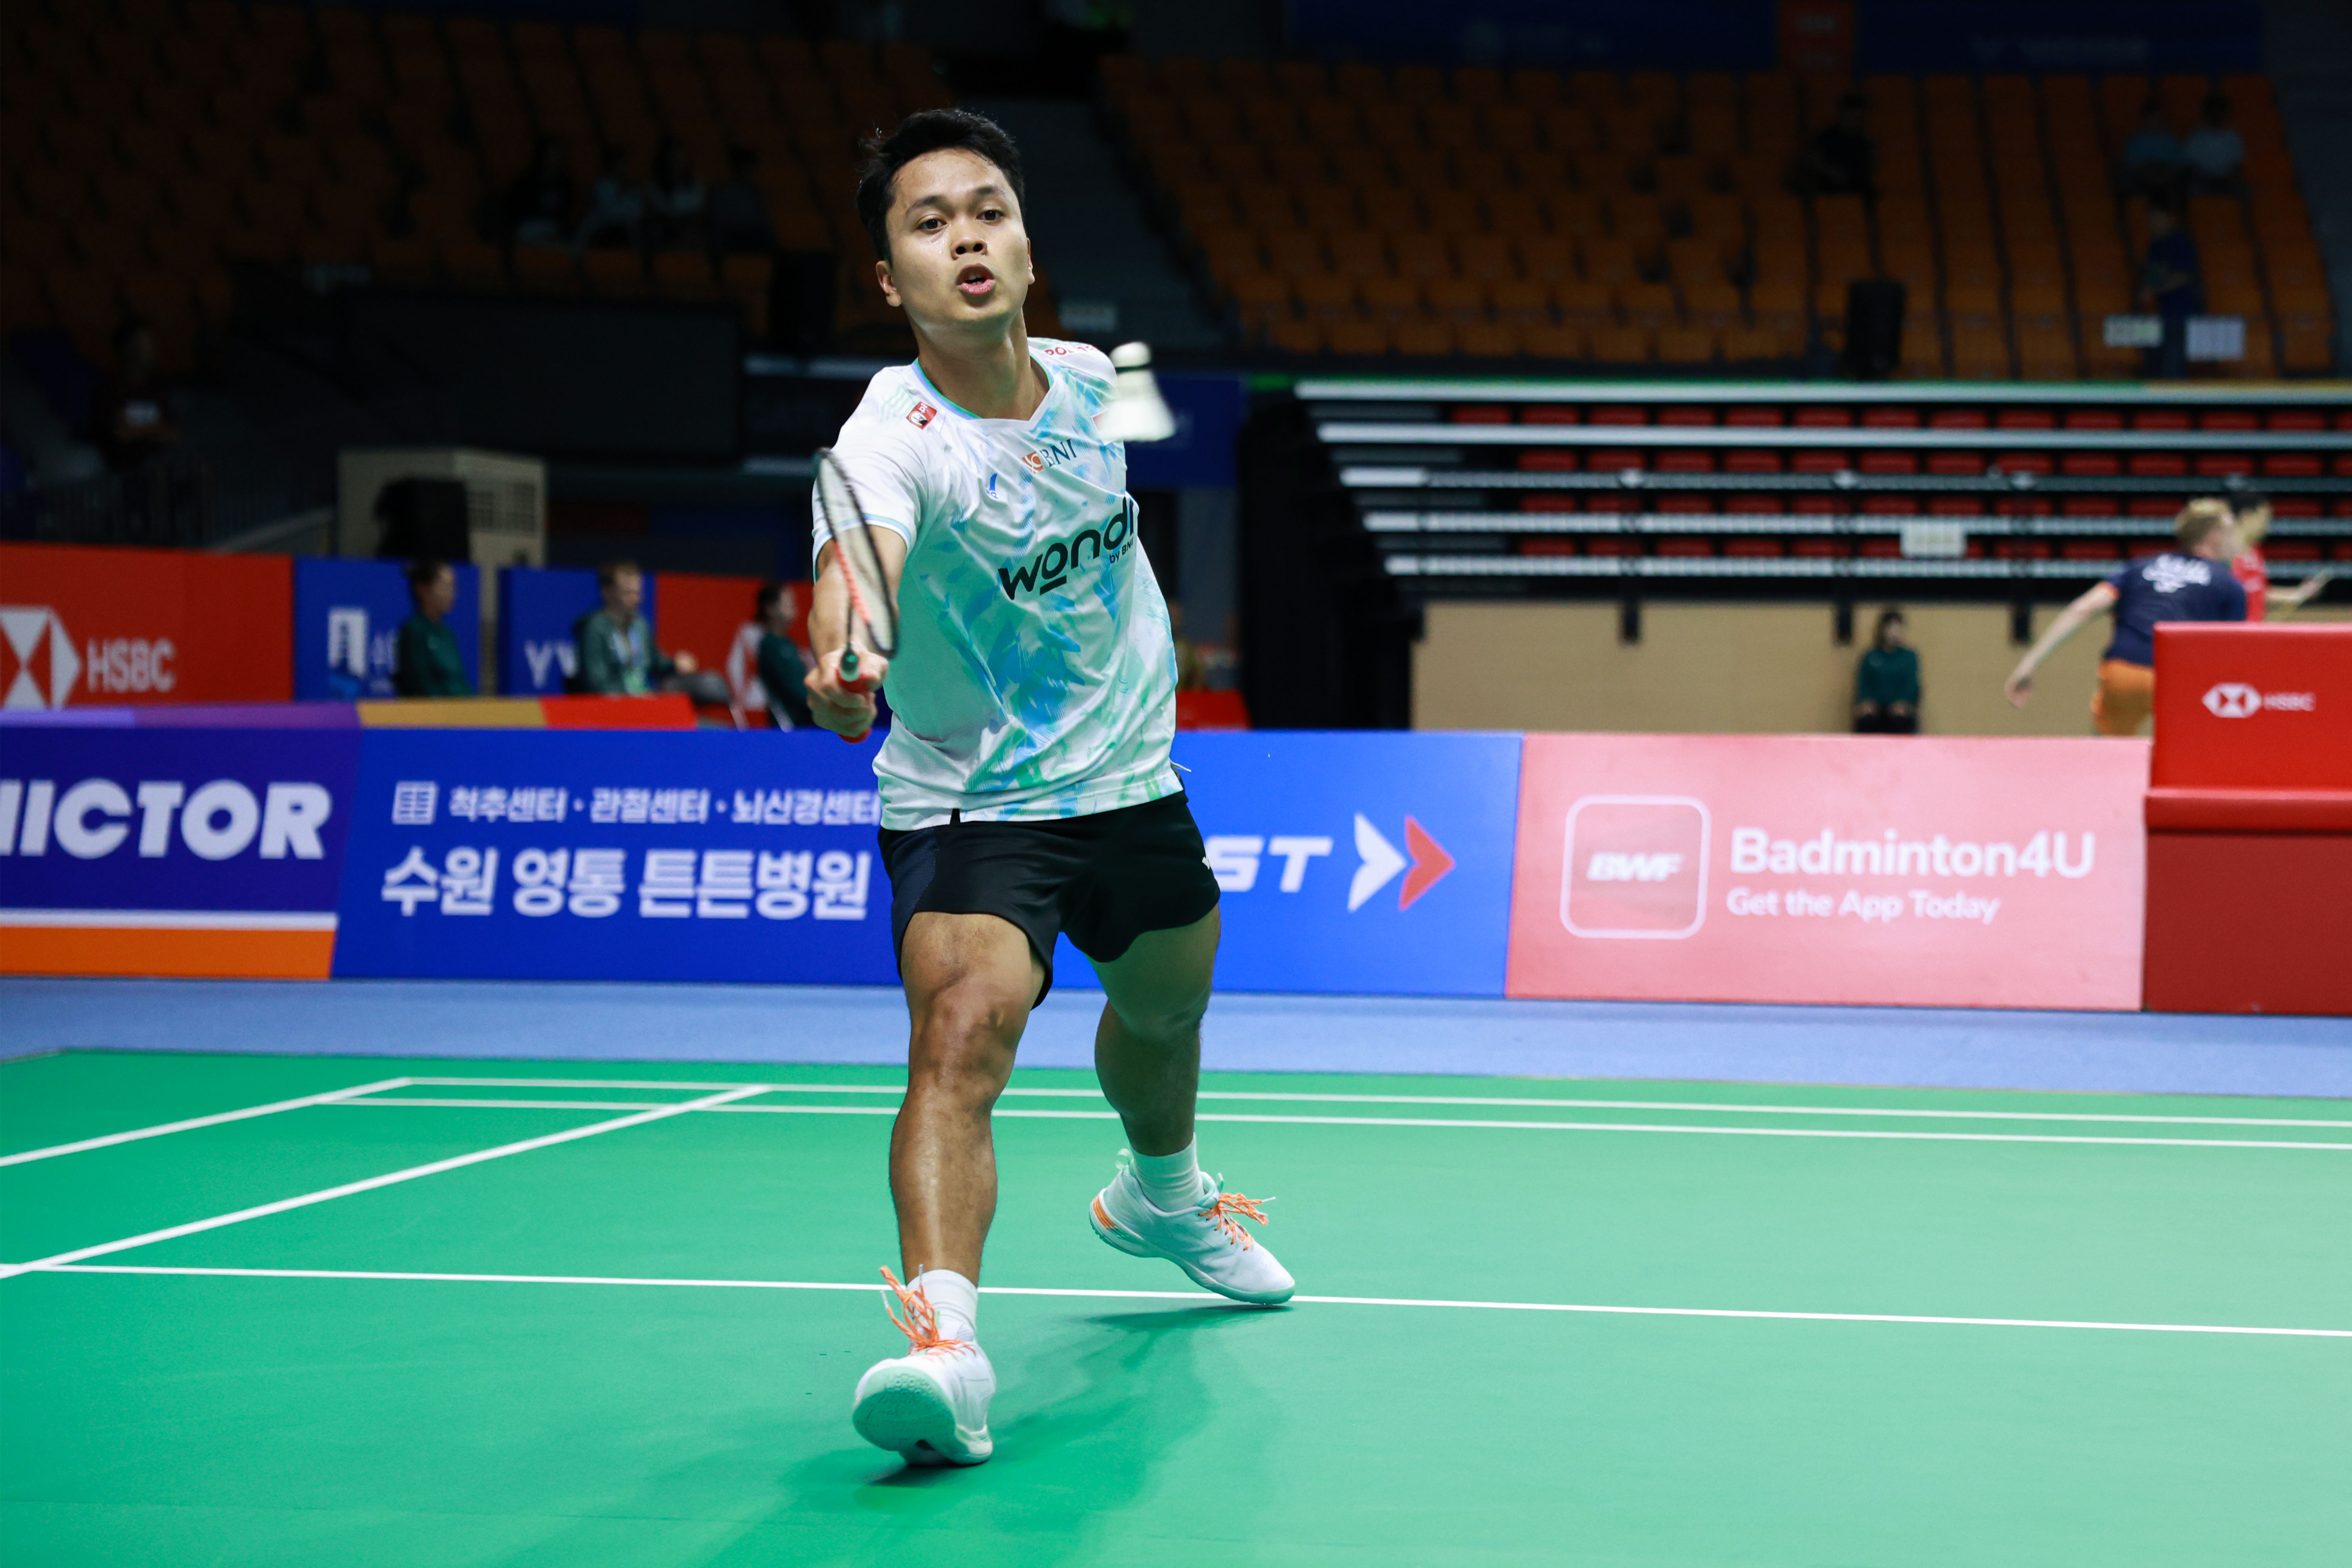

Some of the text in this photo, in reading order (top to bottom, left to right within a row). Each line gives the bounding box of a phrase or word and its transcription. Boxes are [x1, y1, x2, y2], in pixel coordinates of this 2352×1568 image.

[1039, 439, 1077, 468] BNI
[1109, 537, 1133, 564] by BNI
[87, 637, 176, 693] HSBC
[2263, 691, 2316, 711] HSBC
[1587, 852, 1685, 882] BWF
[1731, 827, 2096, 879] Badminton4U
[381, 846, 873, 921] 수원 영통 튼튼병원
[1726, 887, 2002, 925] Get the App Today
